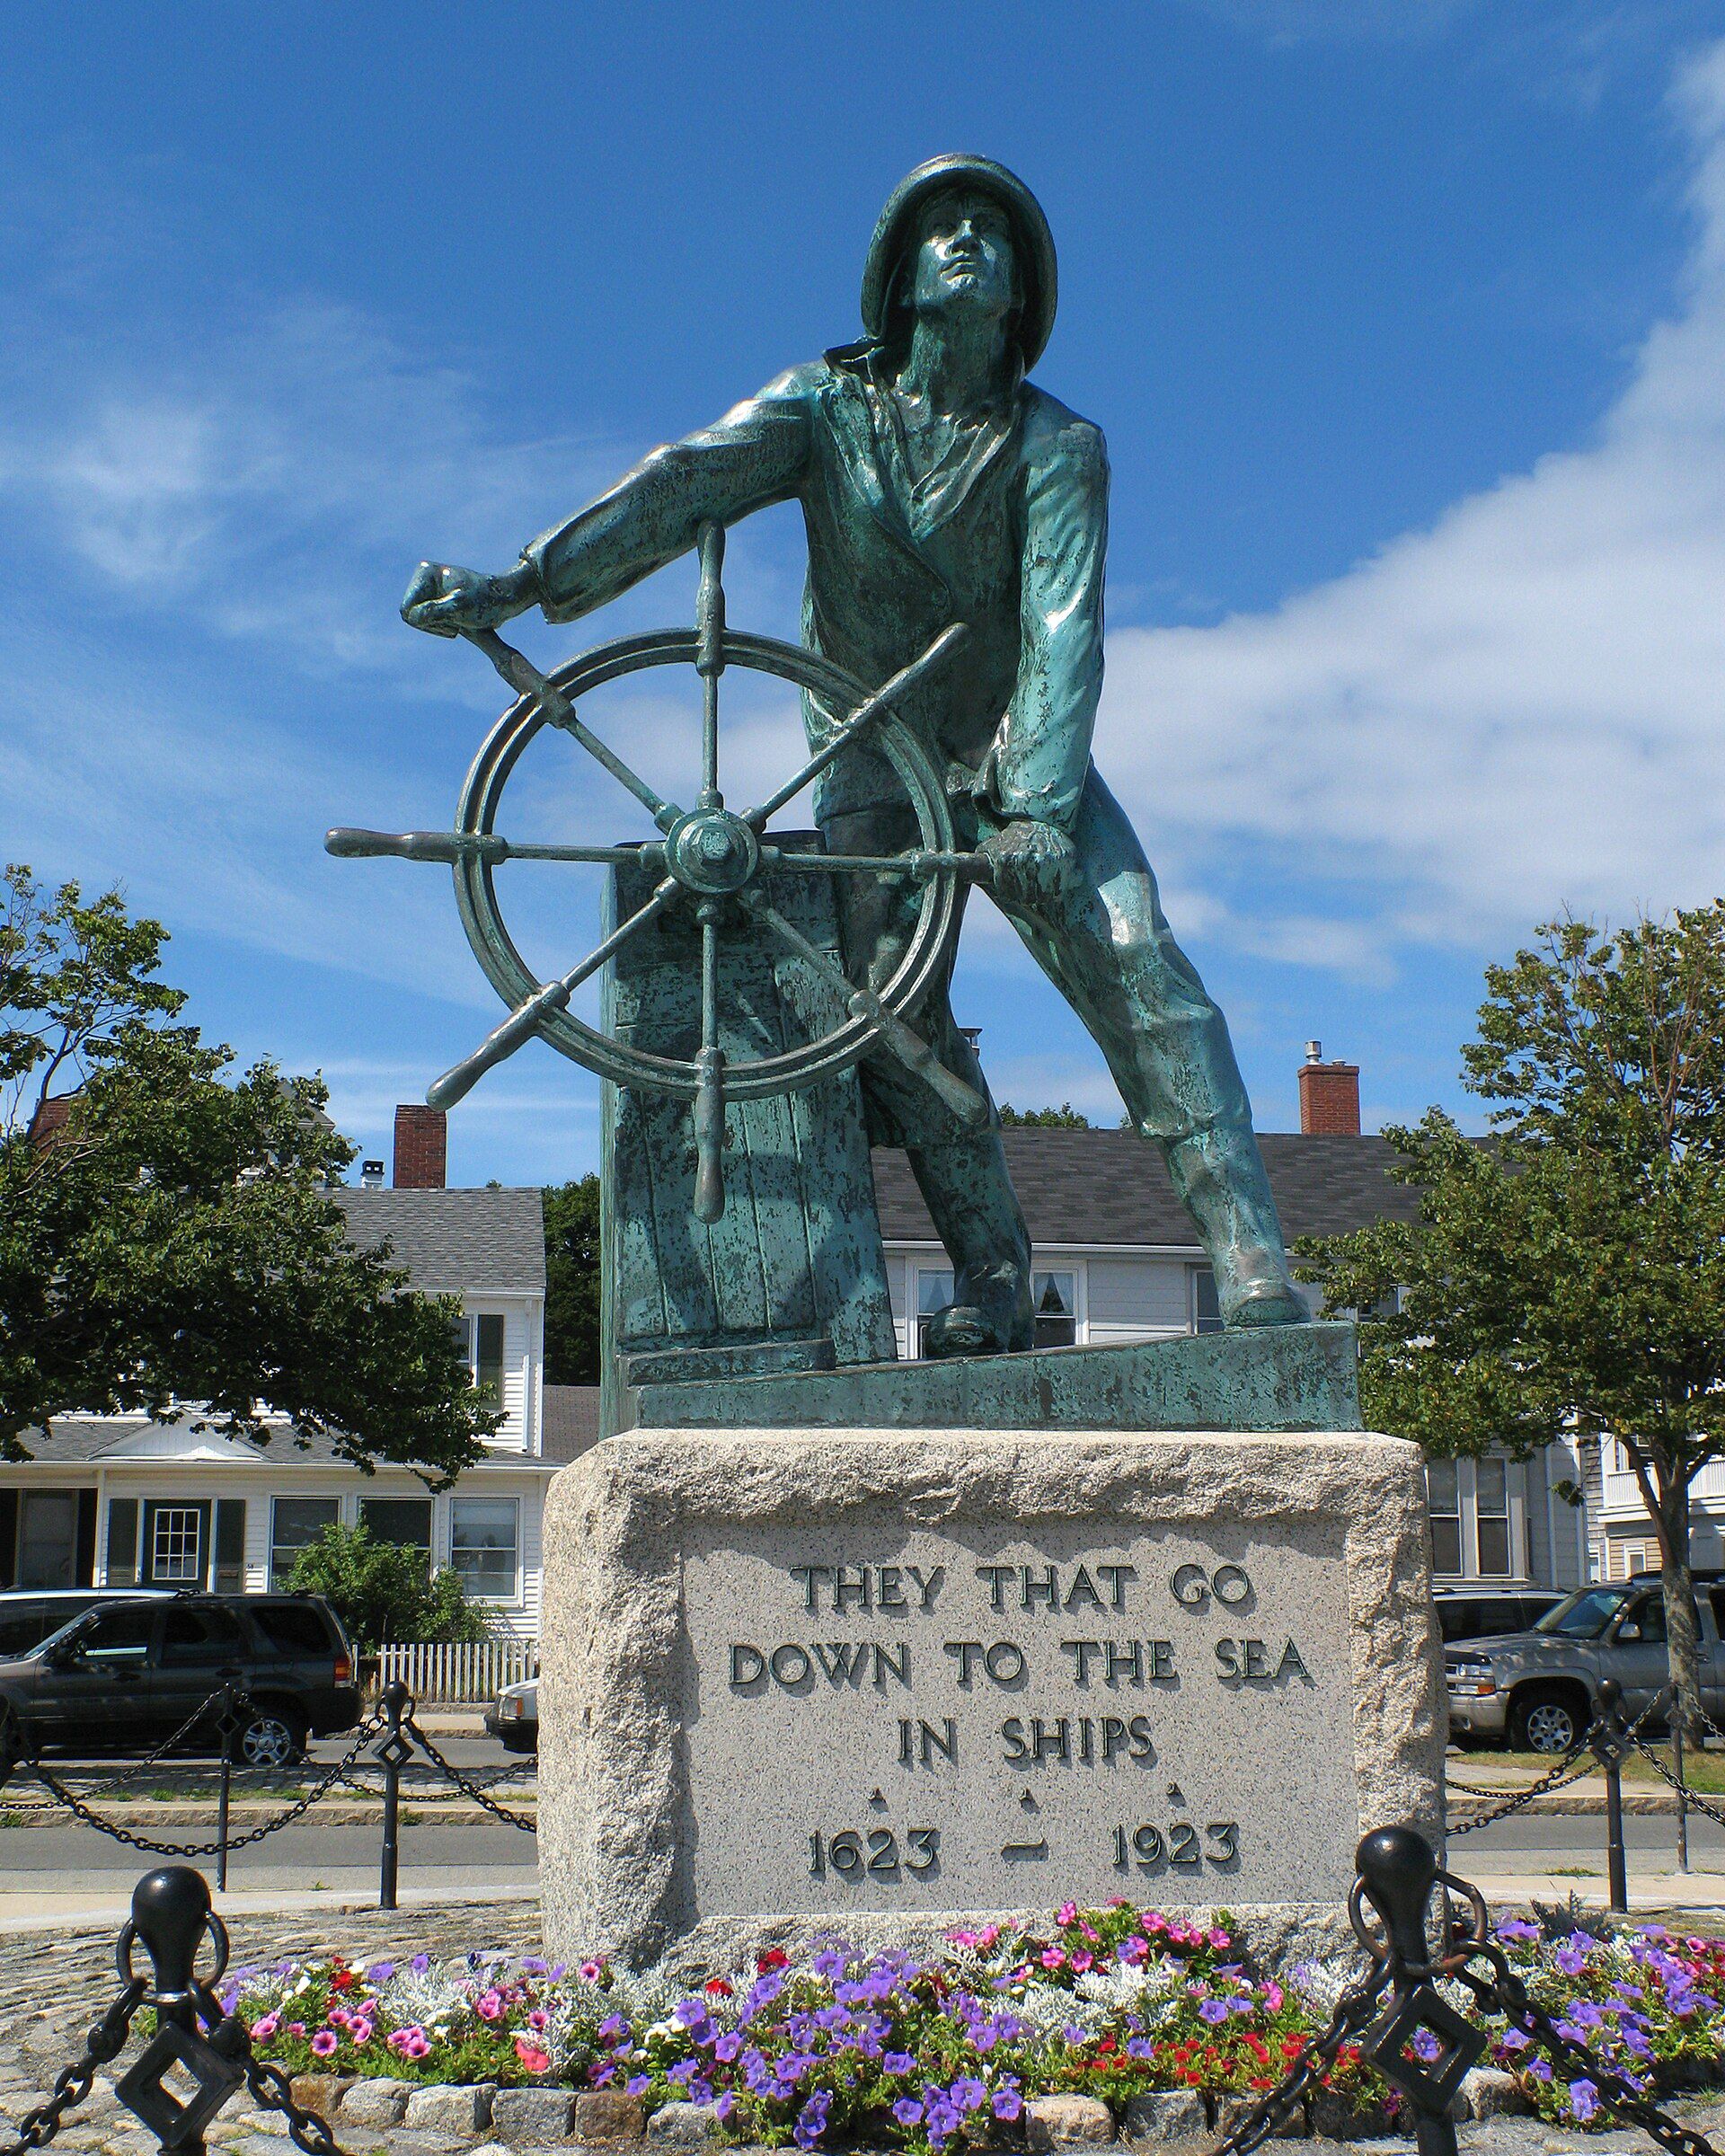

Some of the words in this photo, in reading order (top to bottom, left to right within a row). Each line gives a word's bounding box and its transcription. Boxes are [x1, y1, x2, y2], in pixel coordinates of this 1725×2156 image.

[791, 1566, 943, 1607] THEY
[977, 1563, 1135, 1606] THAT
[1170, 1563, 1249, 1604] GO
[729, 1642, 906, 1685] DOWN
[943, 1641, 1022, 1683] TO
[1061, 1638, 1177, 1680] THE
[1214, 1636, 1312, 1679] SEA
[898, 1716, 955, 1761] IN
[1001, 1714, 1153, 1759] SHIPS
[809, 1827, 936, 1873] 1623
[1110, 1821, 1238, 1865] 1923
